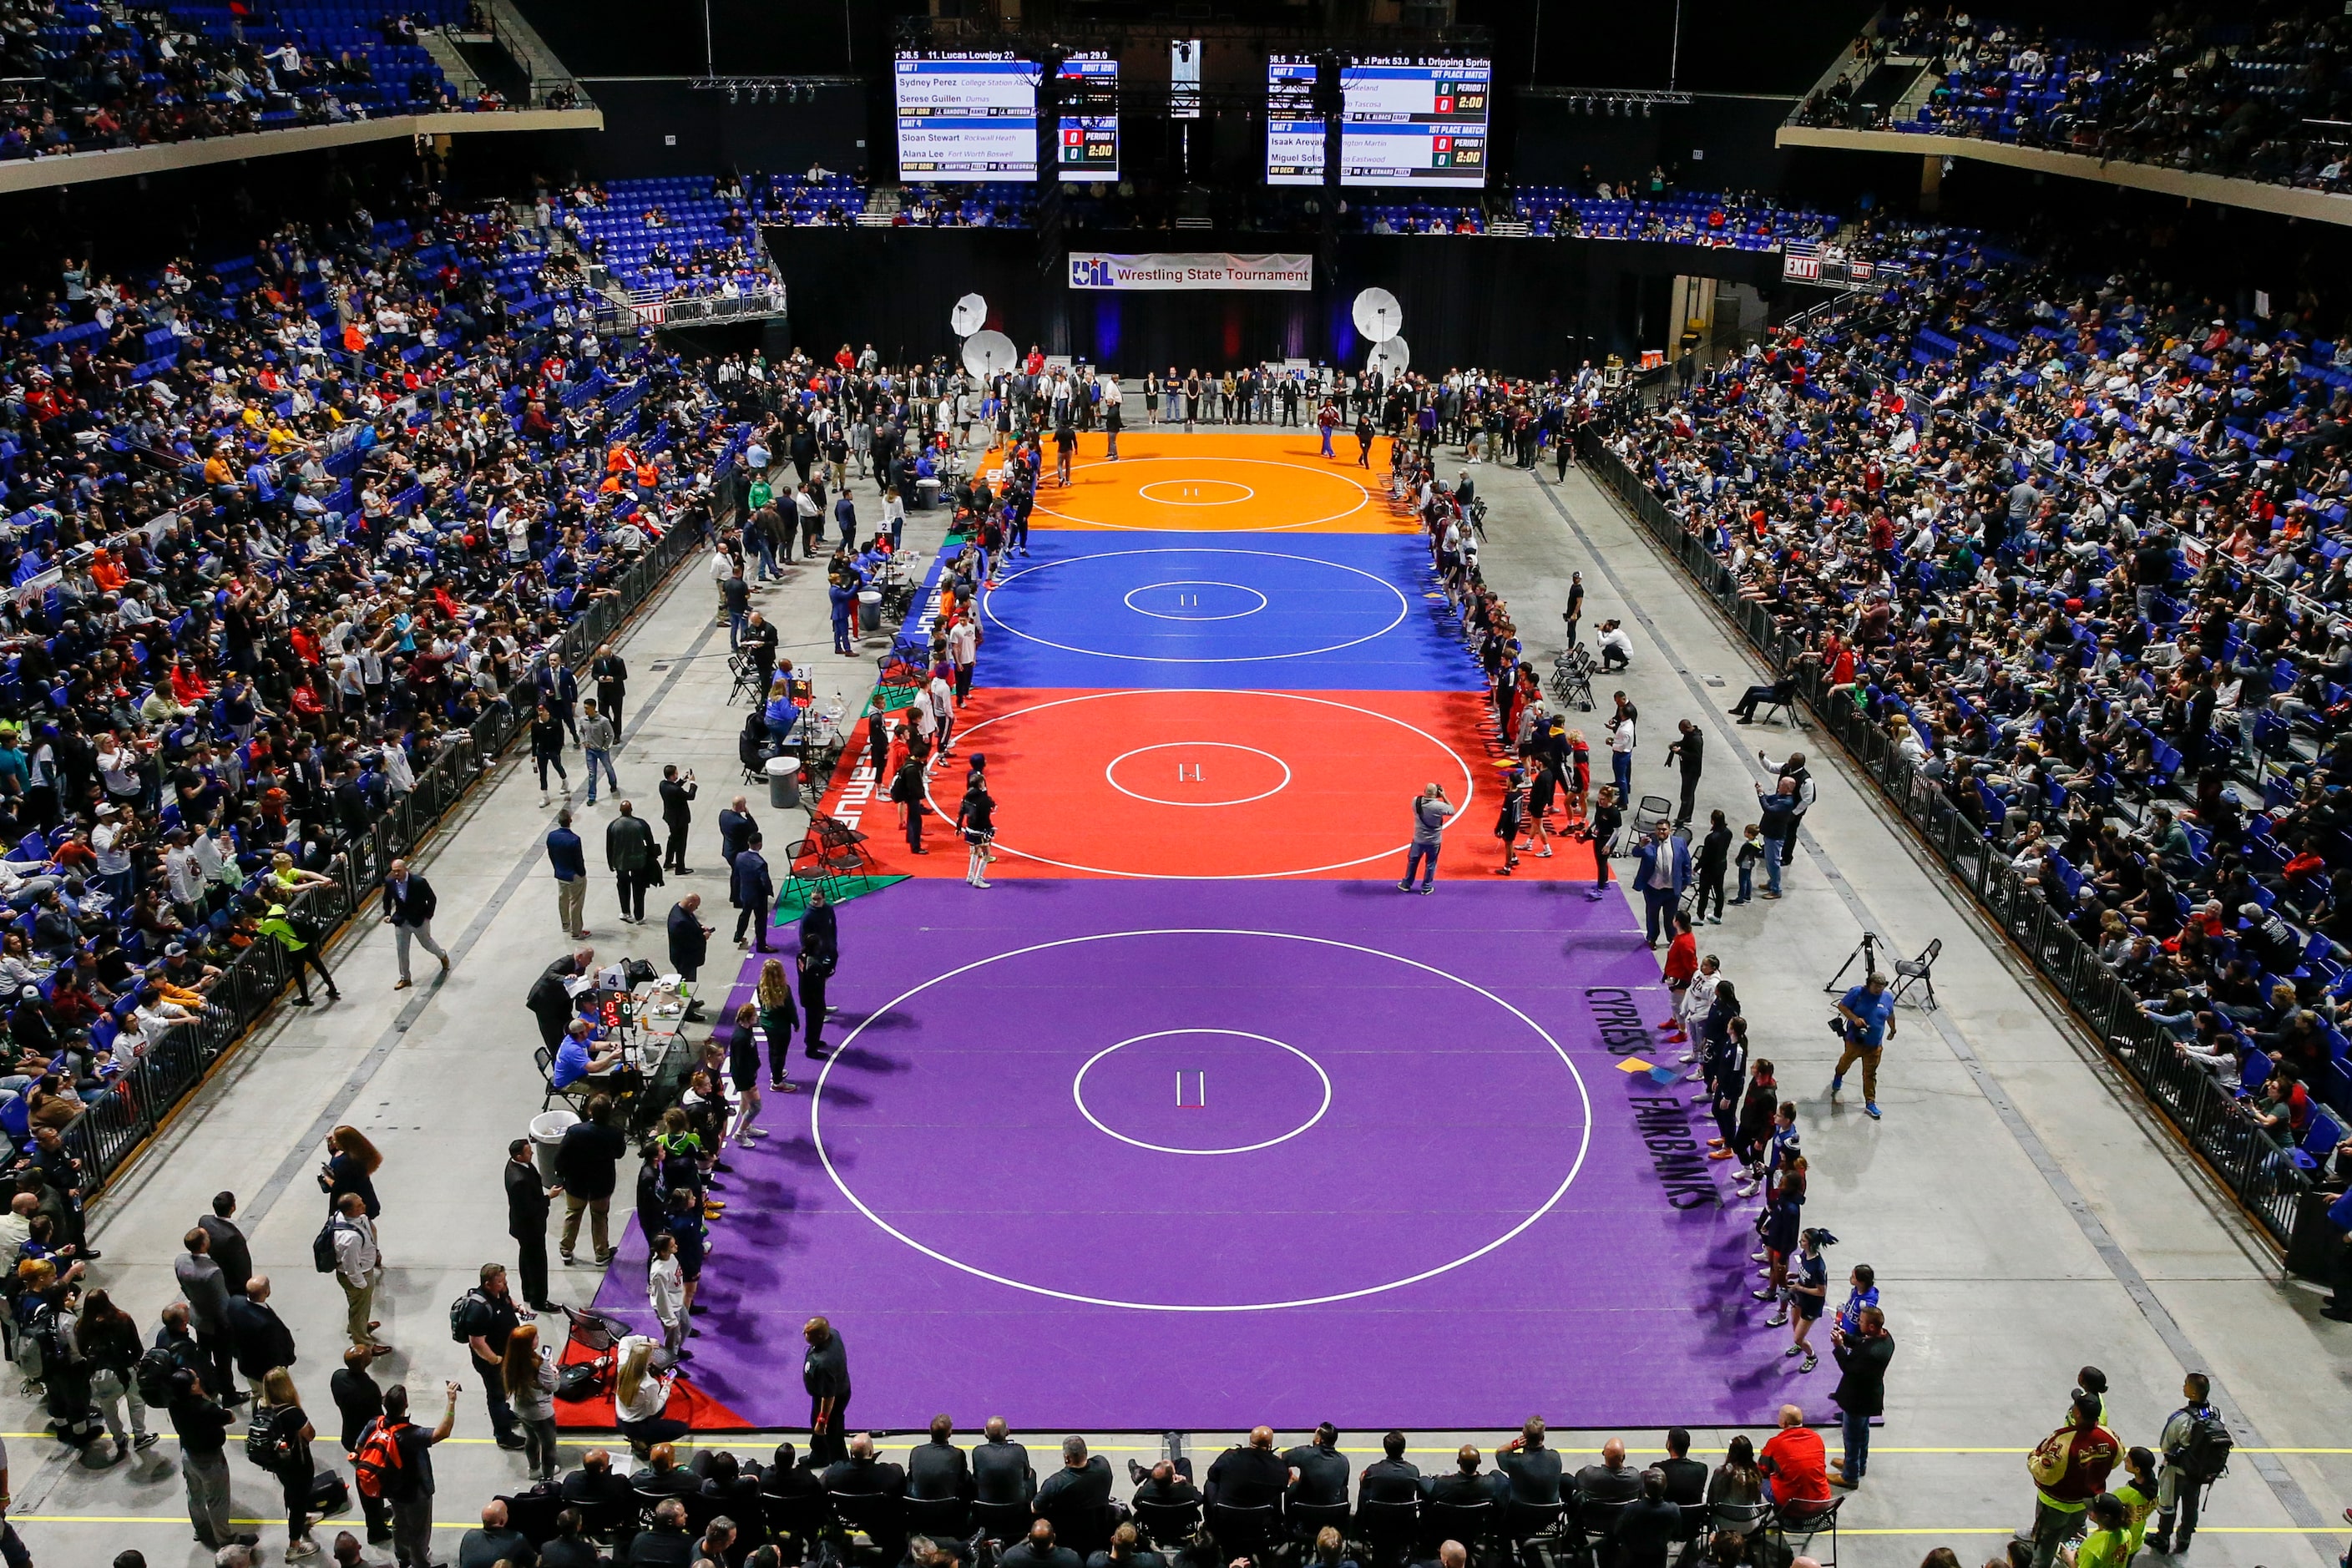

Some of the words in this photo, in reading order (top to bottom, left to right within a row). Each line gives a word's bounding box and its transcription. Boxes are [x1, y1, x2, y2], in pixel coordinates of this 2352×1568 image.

[901, 51, 918, 59] 36.5
[928, 51, 939, 59] 11.
[942, 51, 967, 59] Lucas
[969, 51, 1002, 61] Lovejoy
[1090, 51, 1108, 59] 29.0
[898, 63, 913, 72] MAT
[1371, 57, 1390, 65] Park
[1392, 57, 1409, 65] 53.0
[1428, 58, 1463, 68] Dripping
[1272, 68, 1287, 76] MAT
[1431, 70, 1442, 78] 1ST
[1443, 70, 1463, 78] PLACE
[1464, 71, 1488, 79] MATCH
[899, 78, 930, 88] Sydney
[961, 78, 986, 88] College
[1441, 83, 1449, 94] 0
[932, 94, 961, 103] Guillen
[1459, 96, 1484, 109] 2:00
[1440, 99, 1449, 111] 0
[901, 119, 916, 128] MAT
[916, 119, 922, 128] 4
[1429, 125, 1439, 134] 1ST
[1440, 125, 1461, 134] PLACE
[1462, 126, 1485, 135] MATCH
[902, 134, 926, 142] Sloan
[928, 134, 960, 142] Stewart
[1070, 132, 1078, 144] 0
[1085, 132, 1110, 141] PERIOD
[1438, 138, 1447, 149] 0
[1454, 139, 1479, 148] PERIOD
[903, 149, 926, 158] Alana
[928, 149, 944, 158] Lee
[1070, 148, 1078, 159] 0
[1088, 144, 1113, 157] 2:00
[1271, 154, 1298, 163] Miguel
[1302, 154, 1323, 162] Solis
[1438, 154, 1446, 166] 0
[1456, 151, 1481, 164] 2:00
[1787, 257, 1818, 276] EXIT
[1852, 265, 1870, 276] EXIT
[1118, 268, 1183, 283] Wrestling
[1187, 268, 1222, 280] State
[1226, 268, 1308, 281] Tournament
[882, 523, 888, 531] 2
[797, 668, 803, 678] 3
[607, 974, 619, 988] 4
[623, 1002, 630, 1014] 0
[1585, 988, 1657, 1056] CYPRESS
[1629, 1096, 1725, 1211] FAIRBANKS
